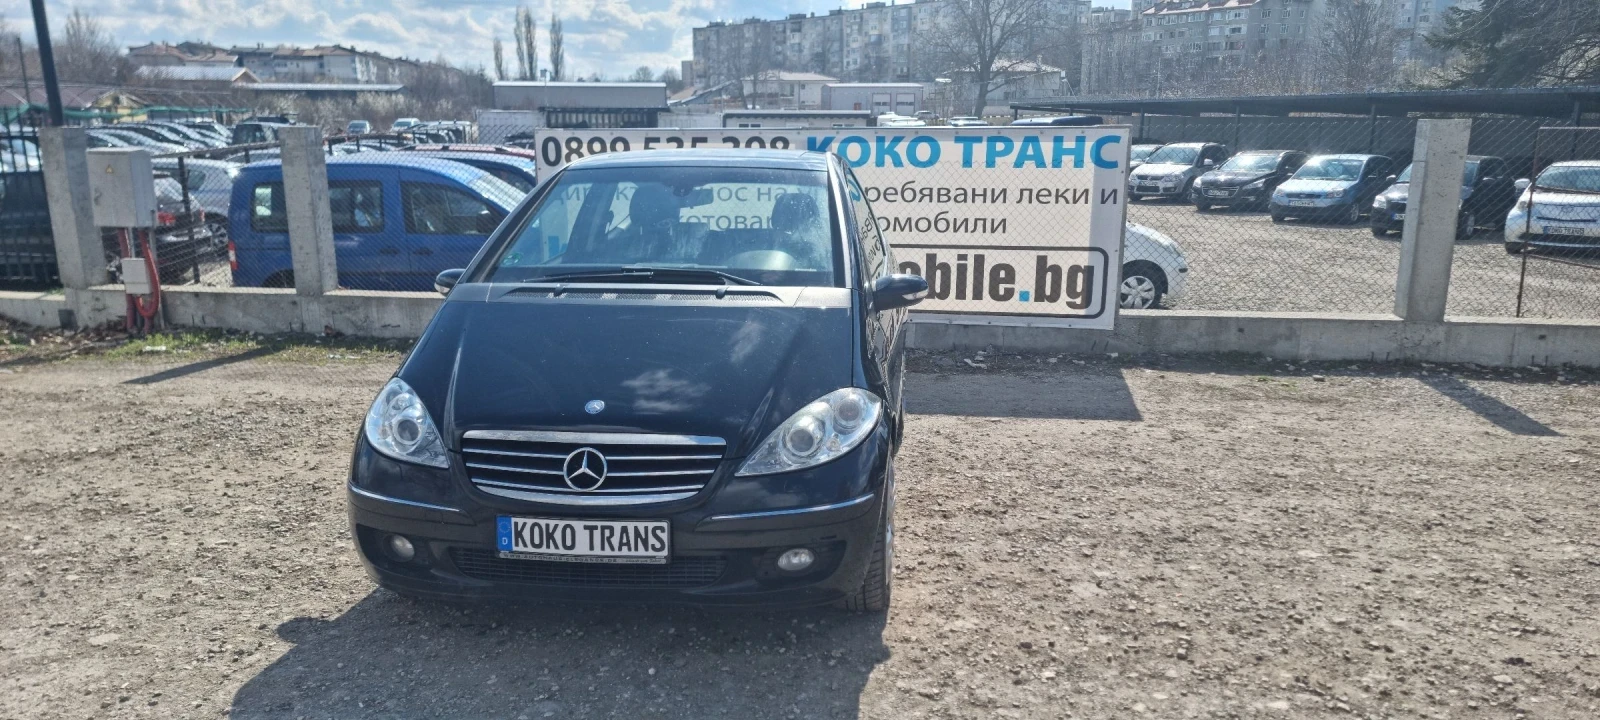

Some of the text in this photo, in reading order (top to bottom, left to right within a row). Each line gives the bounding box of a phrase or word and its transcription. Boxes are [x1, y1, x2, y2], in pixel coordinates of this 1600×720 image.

[806, 135, 941, 169] КОКО
[955, 134, 1122, 169] ТРАНС
[865, 180, 1008, 205] ребявани
[1016, 187, 1090, 205] леки
[1100, 188, 1118, 205] и
[878, 211, 1007, 234] омобили
[899, 253, 1094, 309] bile.bg
[501, 537, 507, 545] D
[513, 521, 666, 553] KOKO TRANS
